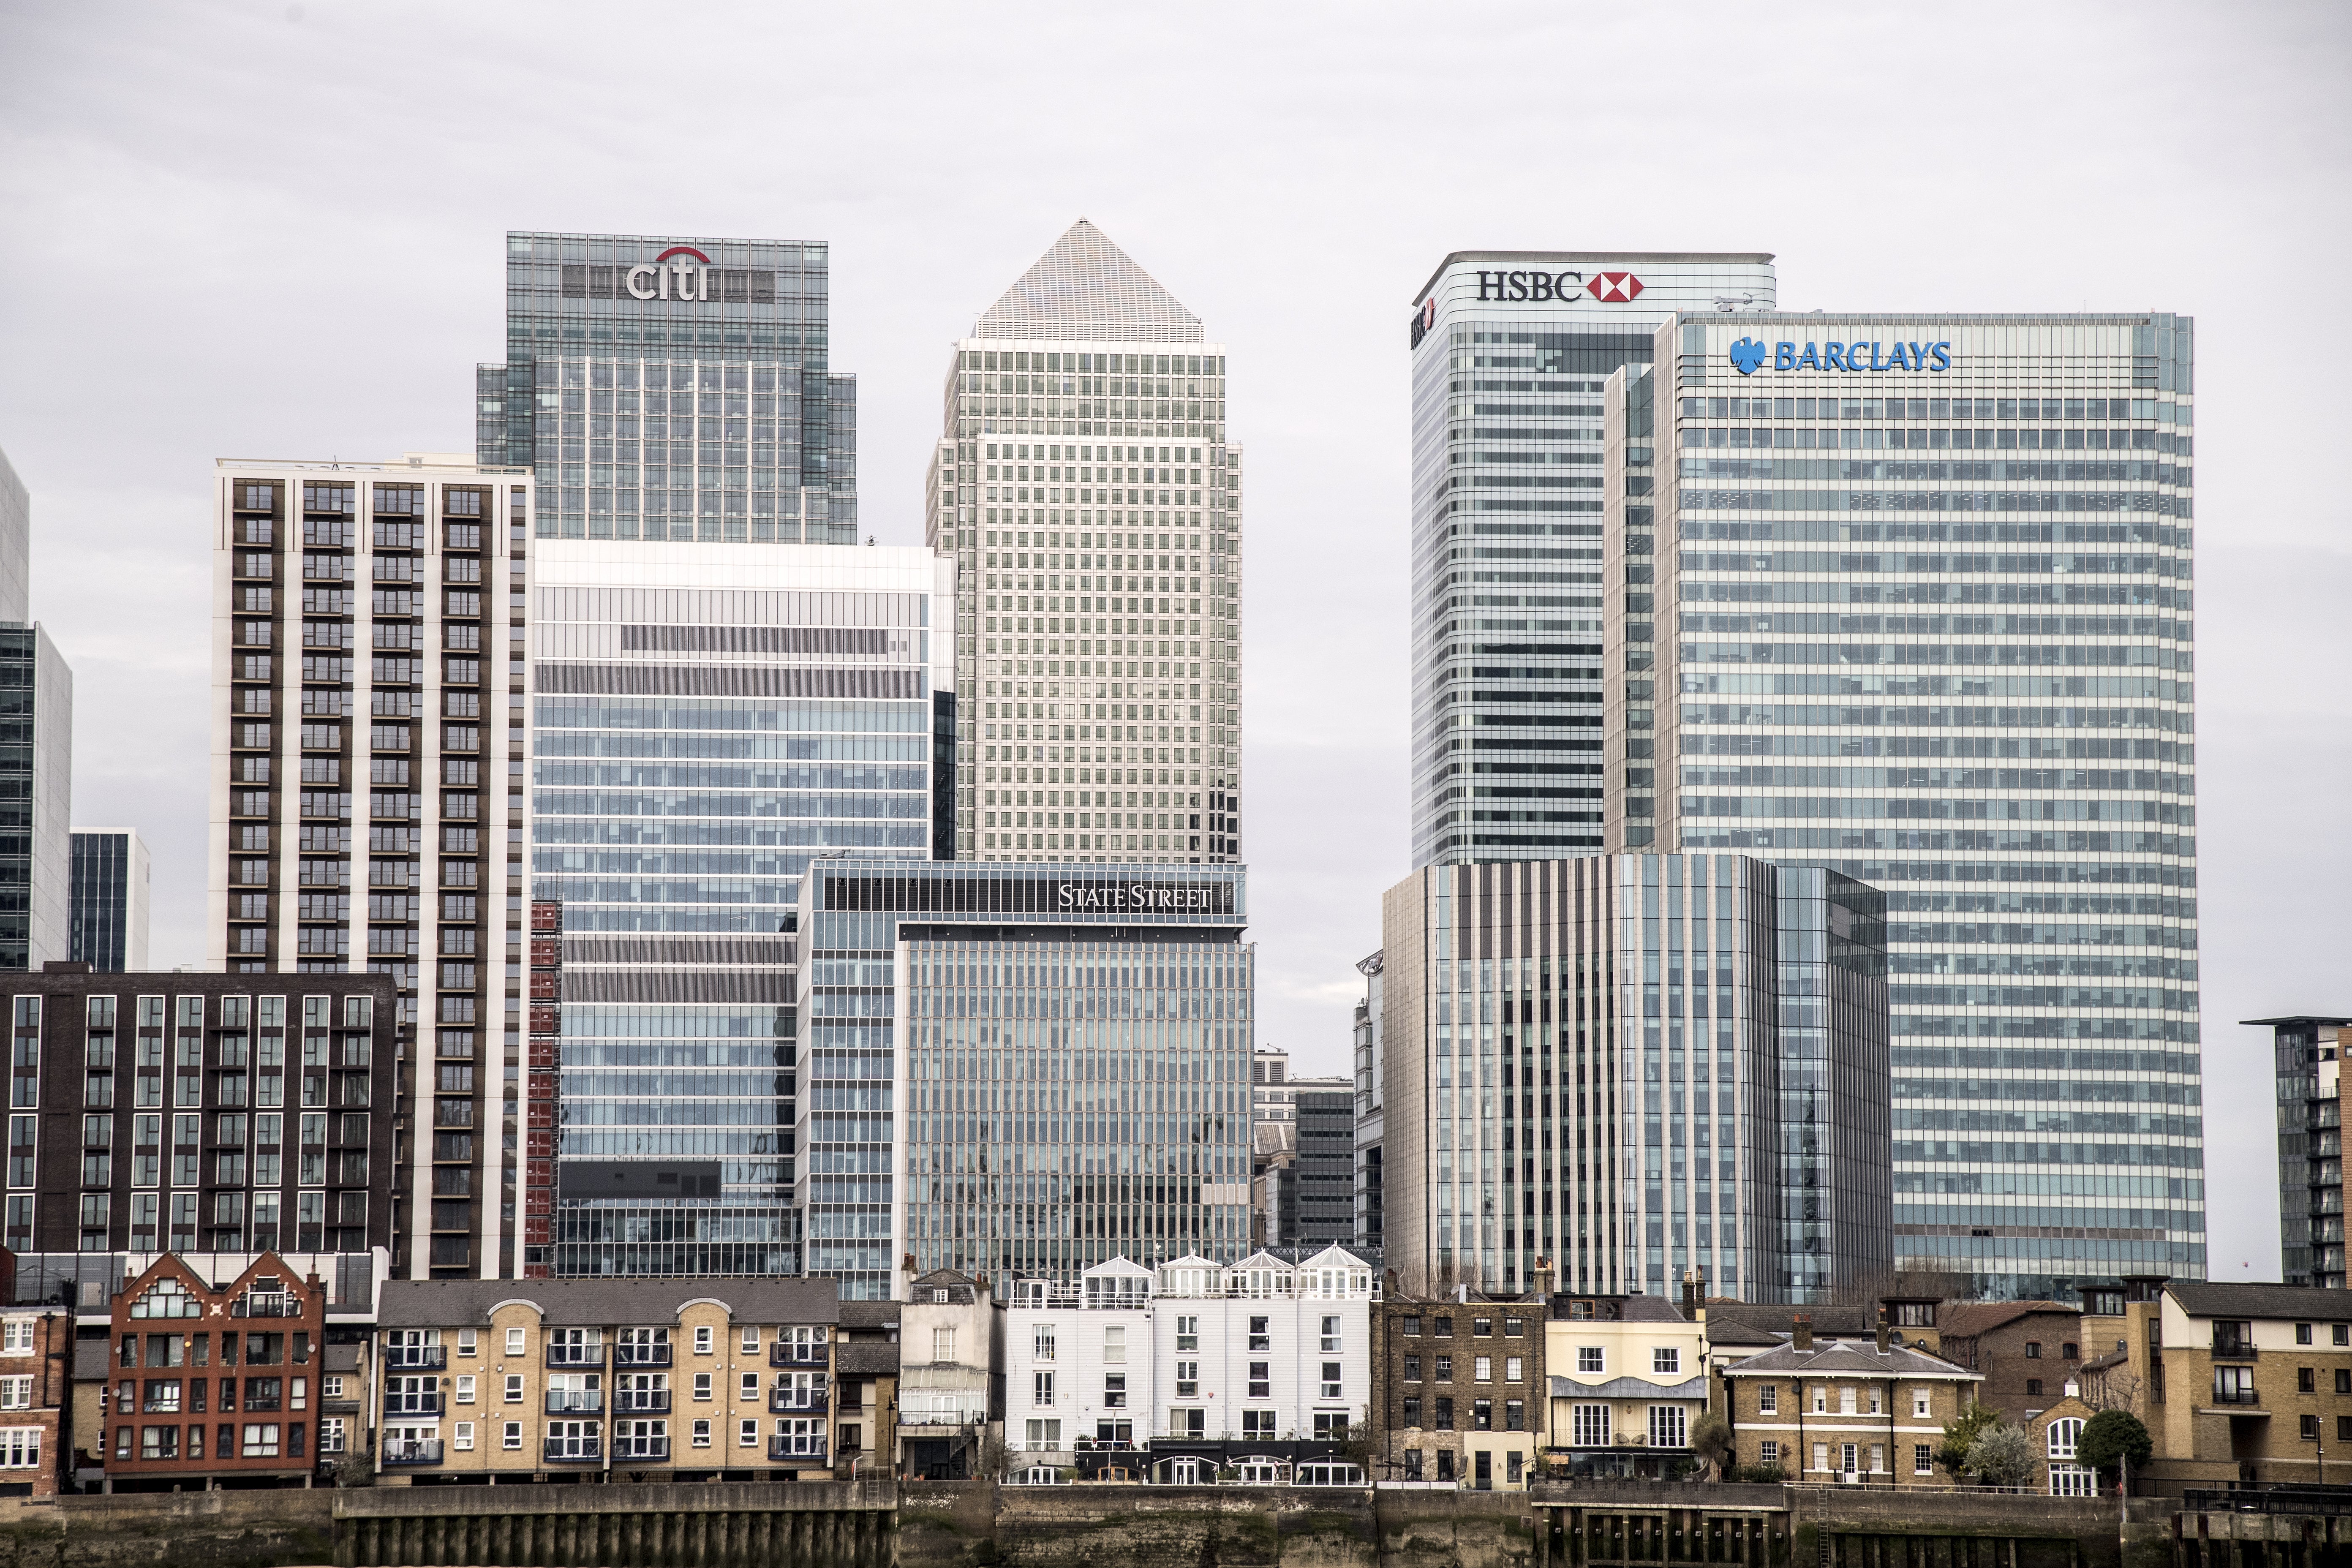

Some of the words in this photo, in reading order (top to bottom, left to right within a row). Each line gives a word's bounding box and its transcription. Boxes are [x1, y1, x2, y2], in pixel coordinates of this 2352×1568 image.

[626, 256, 707, 301] citi
[1476, 271, 1582, 302] HSBC
[1410, 305, 1425, 351] HSBC
[1775, 341, 1951, 371] BARCLAYS
[1059, 884, 1126, 906] STATE
[1131, 885, 1211, 907] STREET
